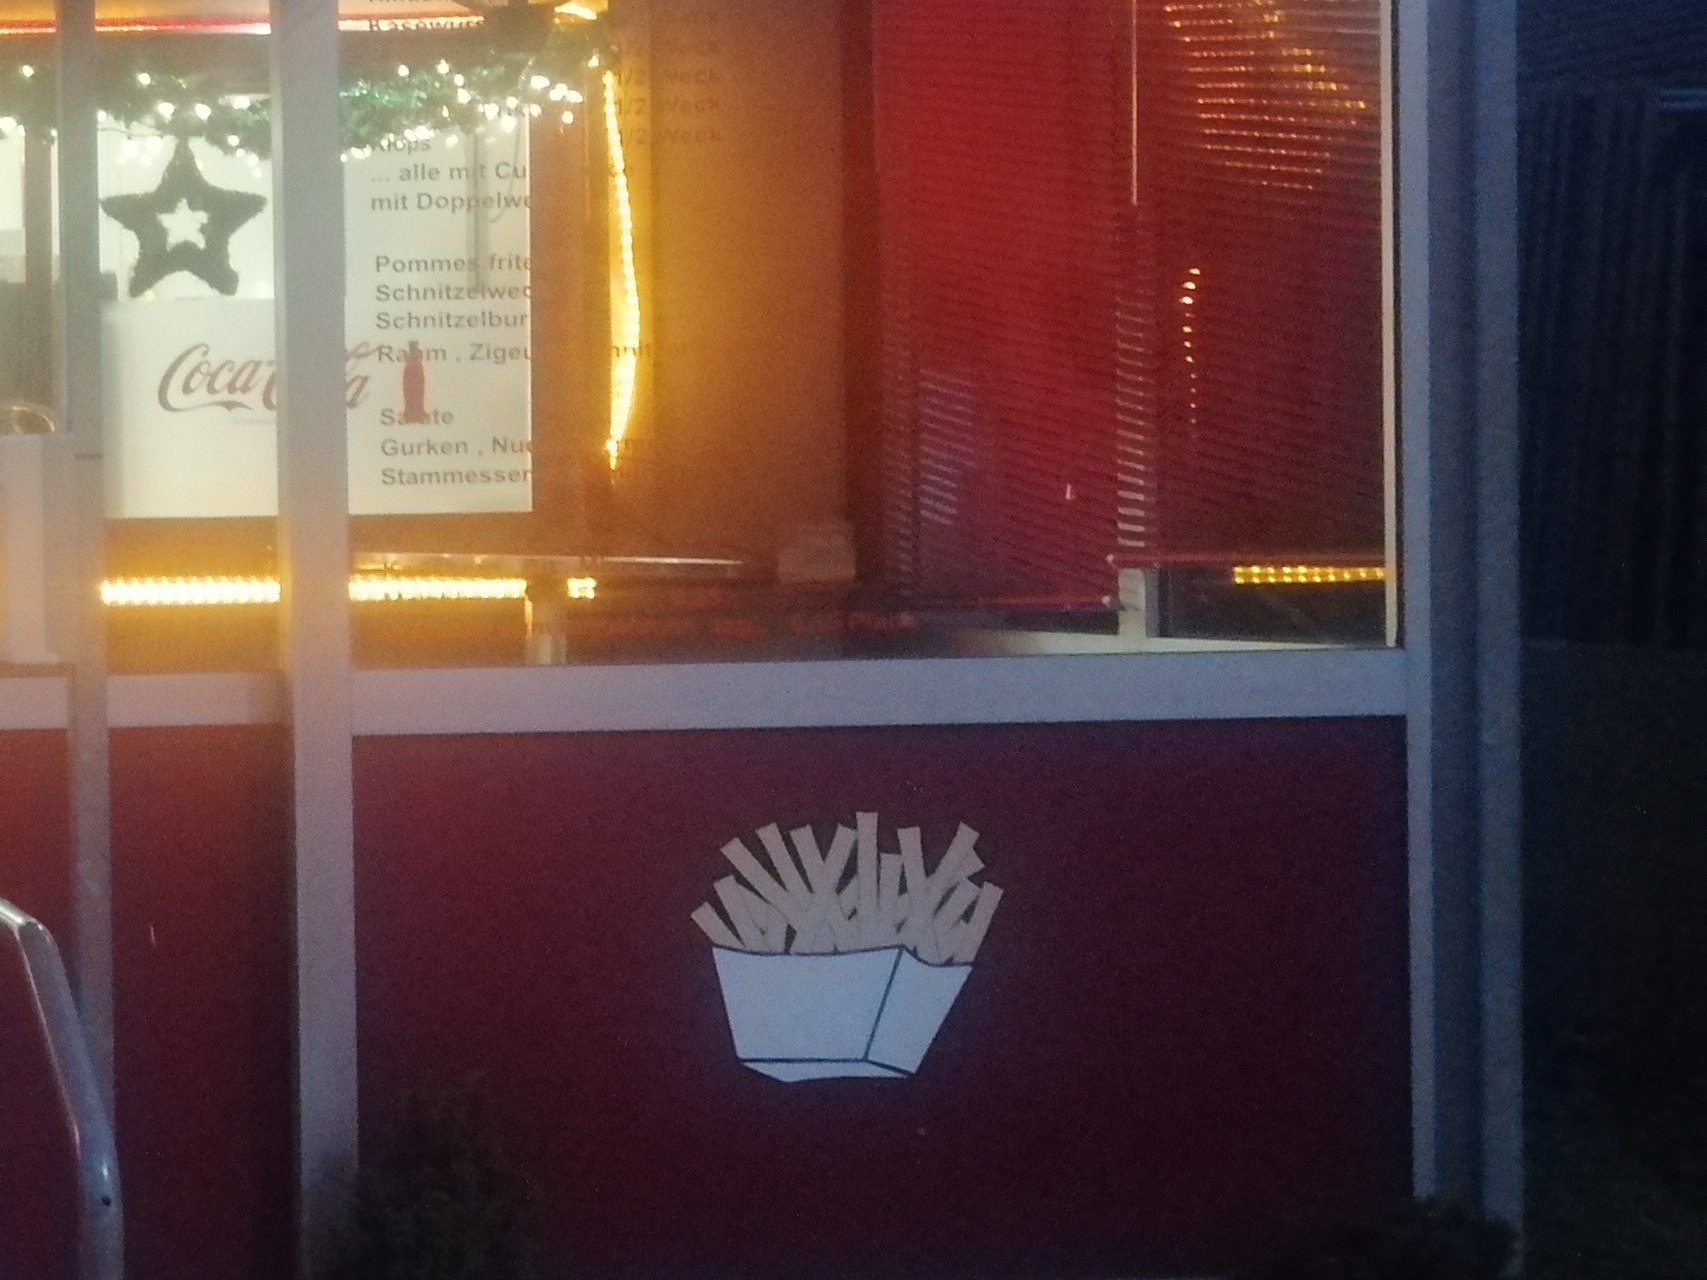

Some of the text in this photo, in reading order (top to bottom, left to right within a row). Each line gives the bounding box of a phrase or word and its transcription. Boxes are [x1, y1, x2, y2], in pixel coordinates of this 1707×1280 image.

[398, 163, 441, 183] alle
[370, 191, 408, 213] mit
[374, 254, 479, 274] Pommes
[376, 342, 448, 365] Ram
[380, 438, 470, 458] Gurken
